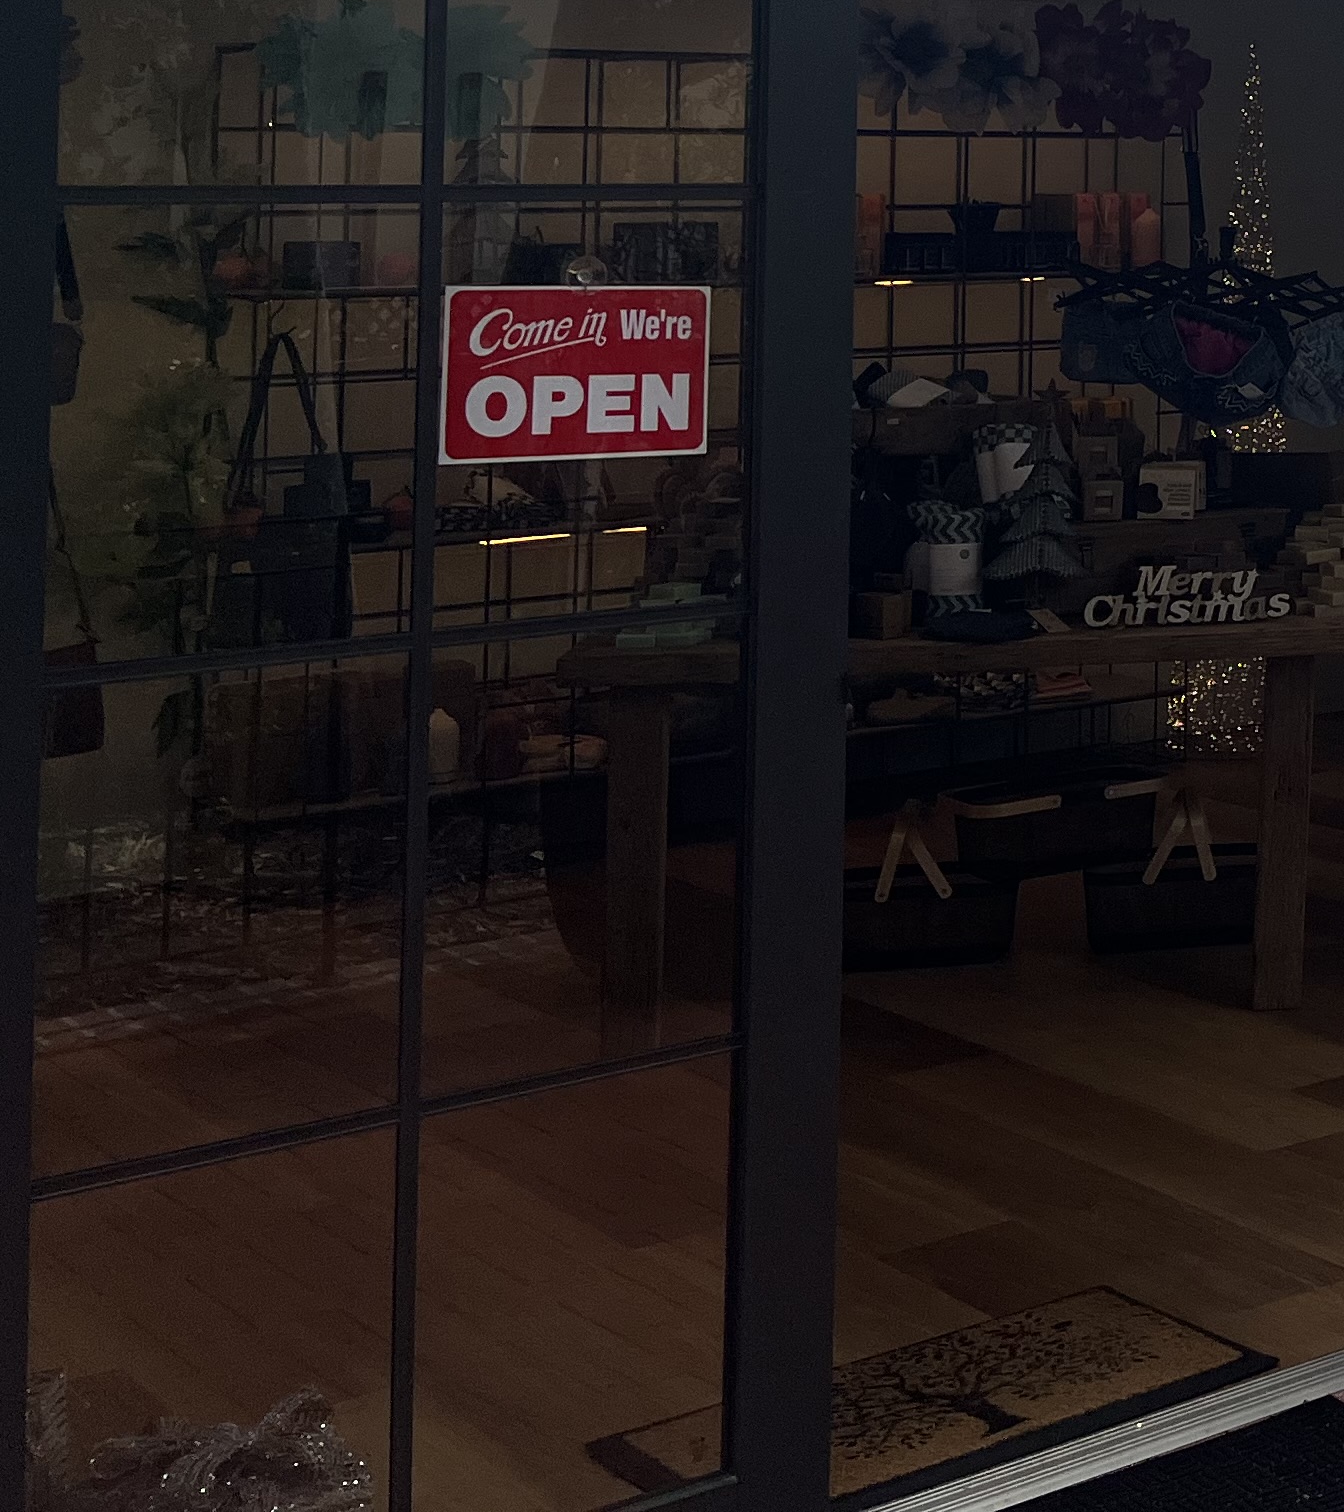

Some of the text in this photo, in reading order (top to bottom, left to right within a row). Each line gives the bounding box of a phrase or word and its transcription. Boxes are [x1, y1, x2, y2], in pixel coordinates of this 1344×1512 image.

[469, 308, 692, 357] Come in We're
[465, 373, 690, 438] OPEN
[1132, 565, 1259, 600] Merry
[1084, 592, 1291, 628] Christmas
